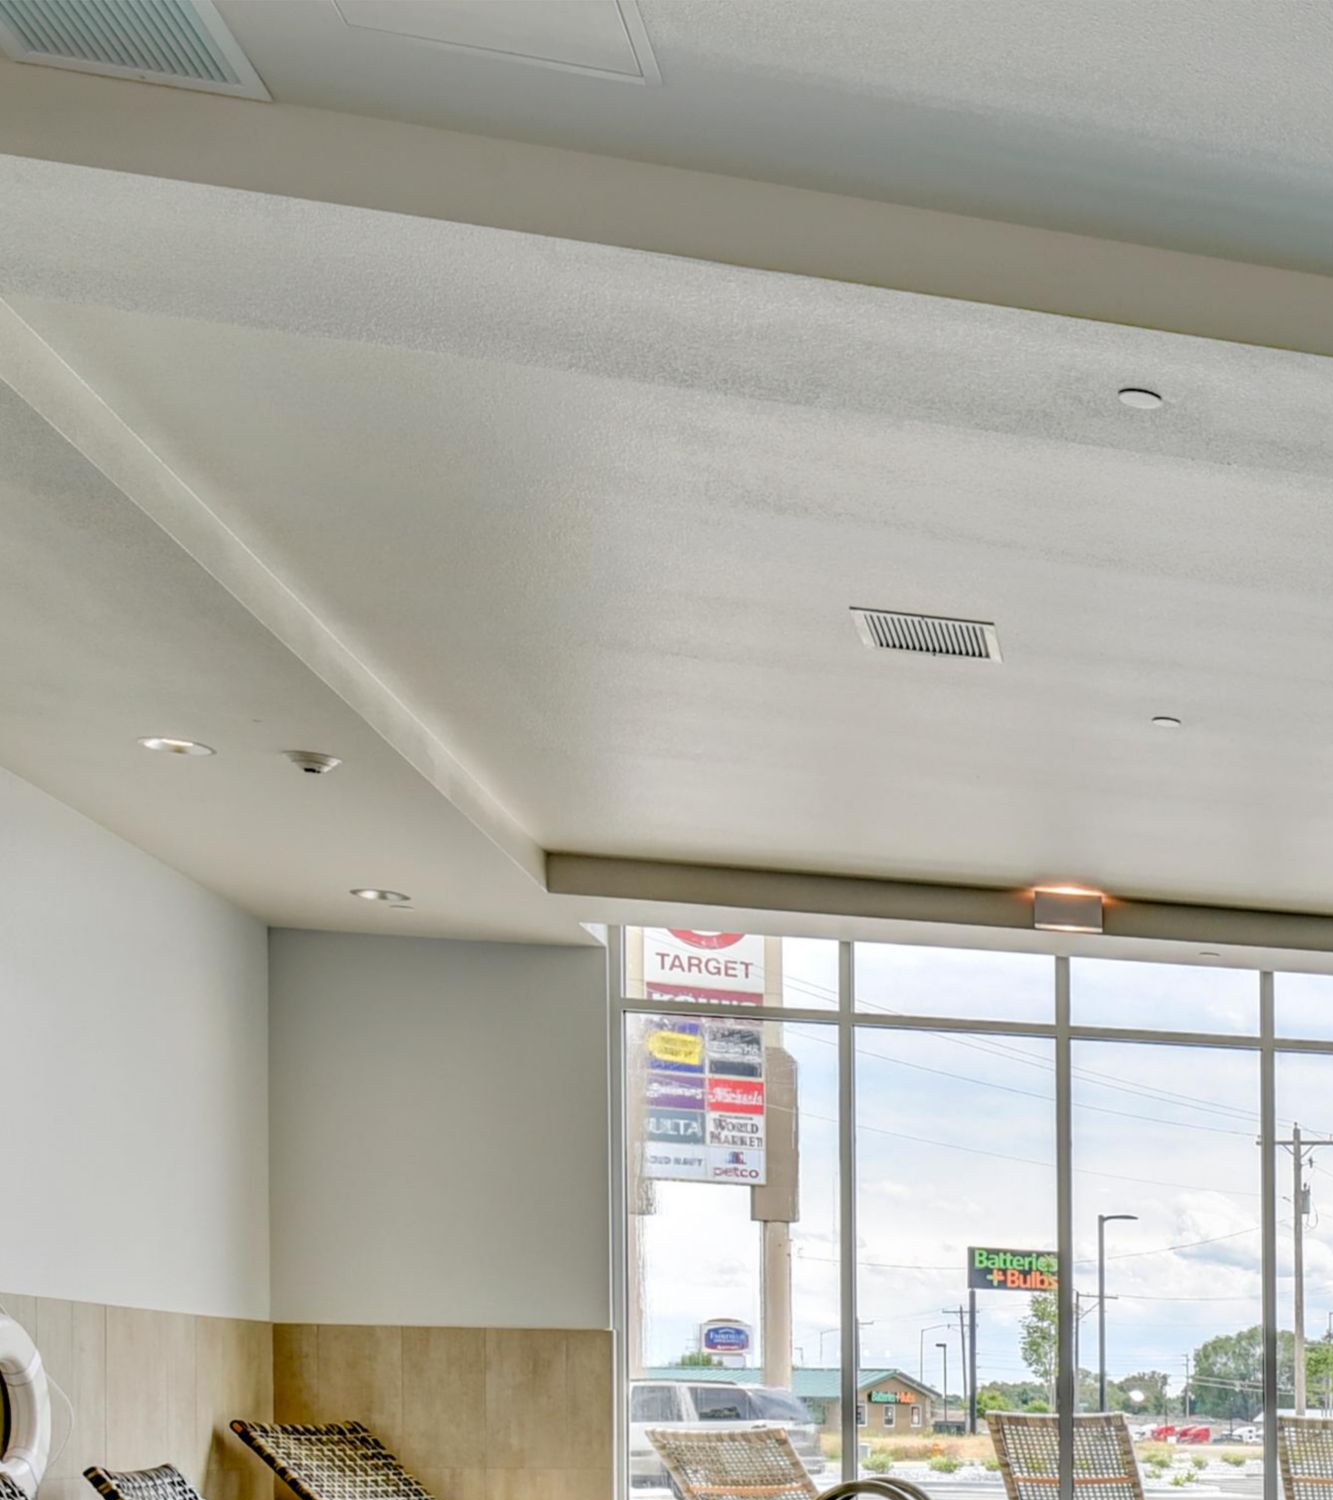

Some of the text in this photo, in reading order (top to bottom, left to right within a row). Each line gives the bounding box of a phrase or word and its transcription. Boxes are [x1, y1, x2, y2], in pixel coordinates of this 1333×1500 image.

[655, 952, 754, 979] TARGET
[713, 1167, 759, 1178] petco
[975, 1249, 1058, 1272] Batteries
